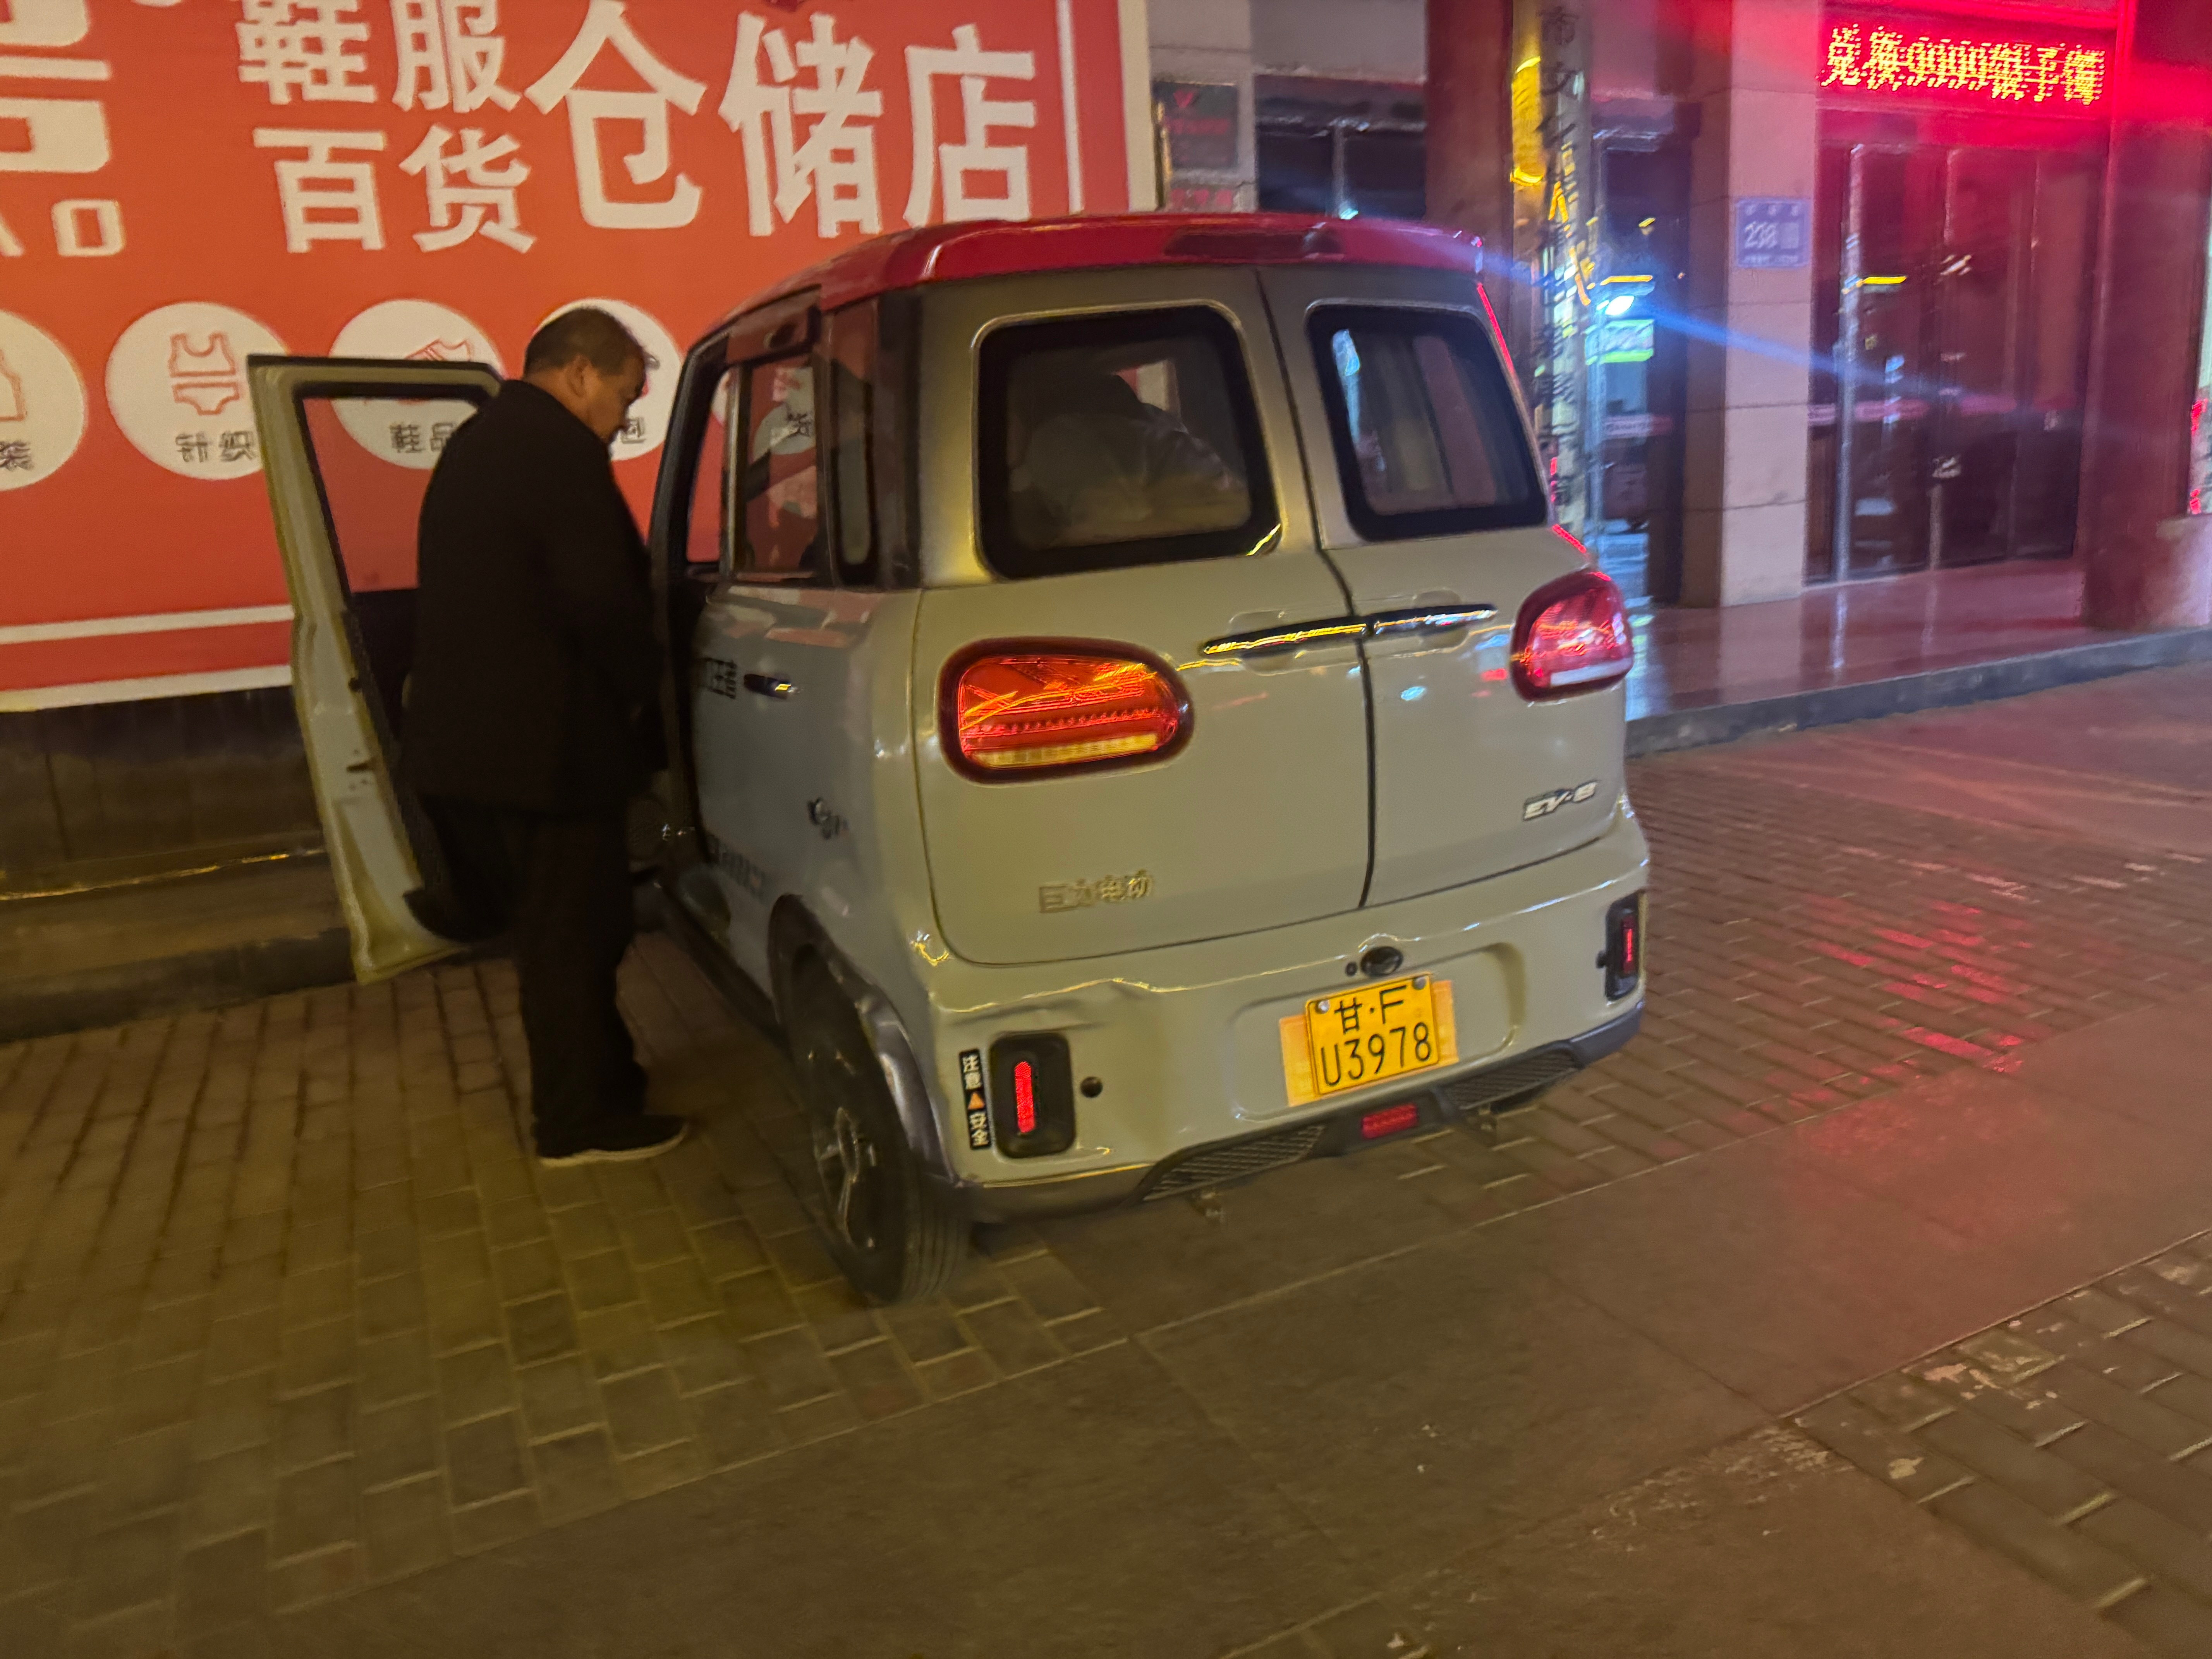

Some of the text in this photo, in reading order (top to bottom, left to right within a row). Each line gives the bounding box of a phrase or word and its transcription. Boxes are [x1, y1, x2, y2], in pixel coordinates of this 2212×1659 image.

[235, 0, 522, 112] 鞋服
[524, 0, 1037, 238] 仓储店
[252, 123, 537, 254] 百货
[1321, 1022, 1432, 1087] U3978
